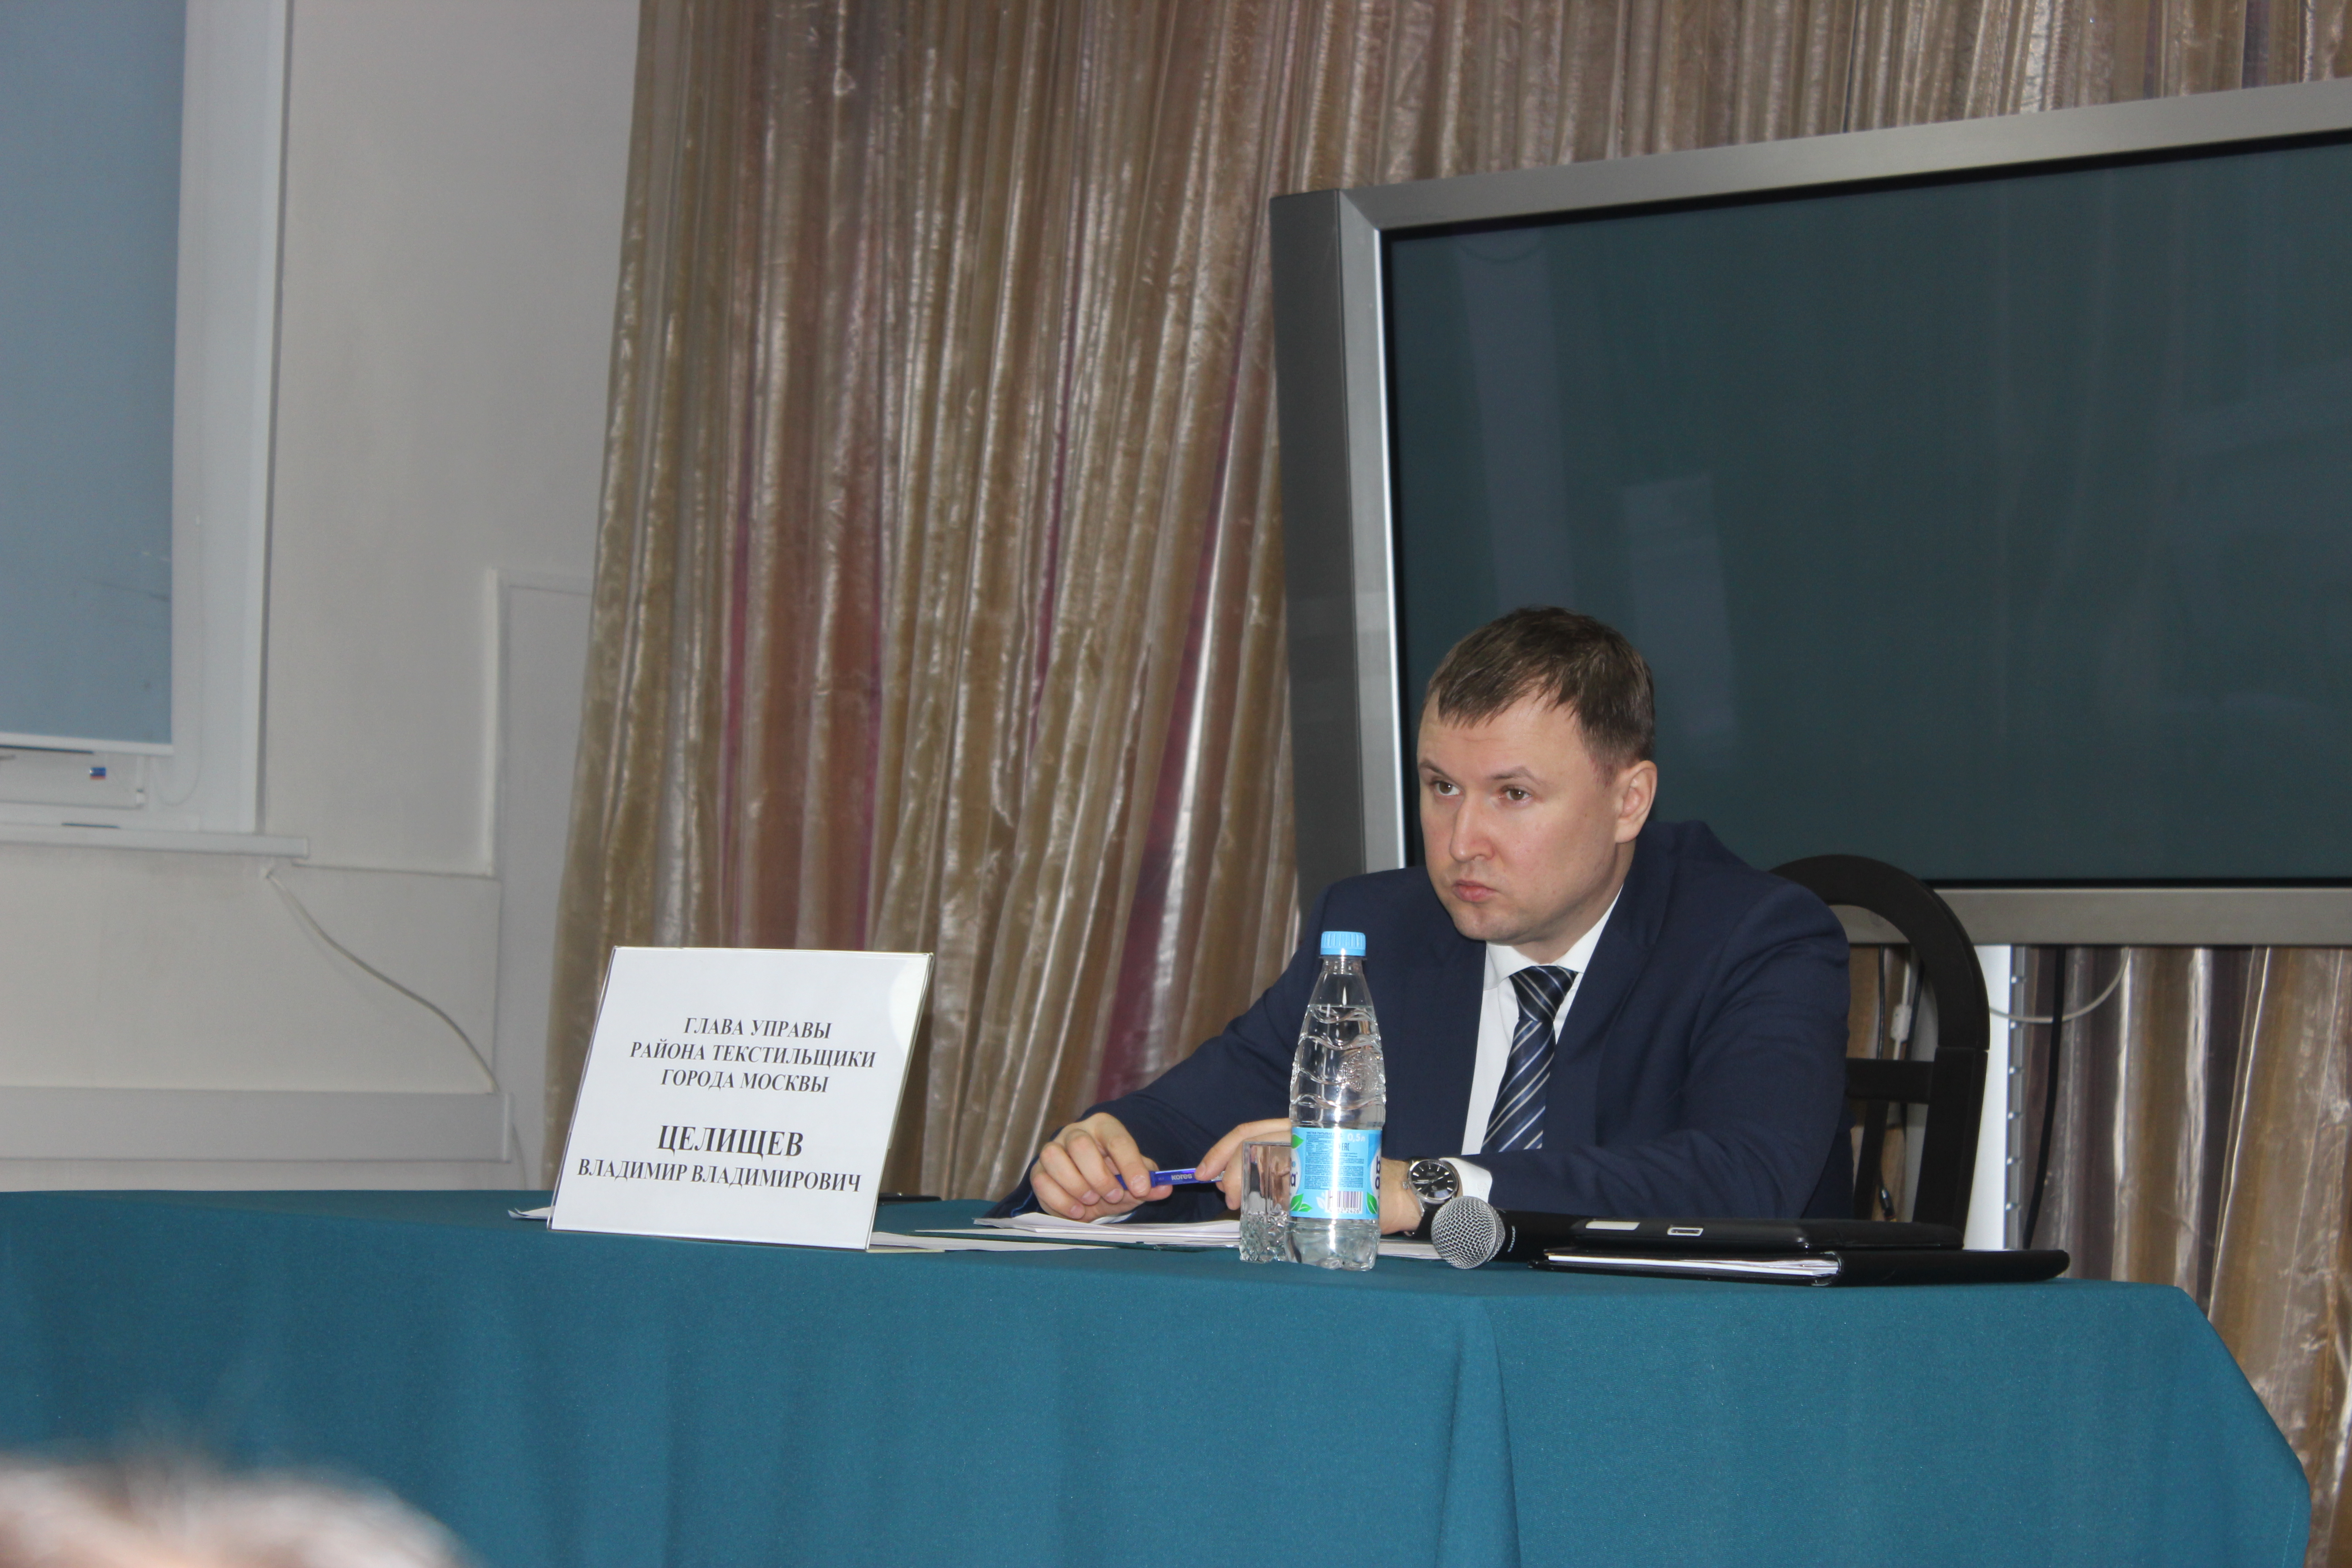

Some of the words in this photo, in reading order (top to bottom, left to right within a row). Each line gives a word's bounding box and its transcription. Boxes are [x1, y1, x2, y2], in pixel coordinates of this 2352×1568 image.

[683, 1018, 743, 1036] ГЛАВА
[750, 1020, 832, 1039] УПРАВЫ
[630, 1039, 705, 1060] РАЙОНА
[713, 1045, 876, 1068] ТЕКСТИЛЬЩИКИ
[661, 1069, 734, 1089] ГОРОДА
[740, 1073, 829, 1093] МОСКВЫ
[657, 1125, 804, 1160] ЦЕЛИЩЕВ
[578, 1158, 687, 1181] ВЛАДИМИР
[691, 1165, 861, 1192] ВЛАДИМИРОВИЧ
